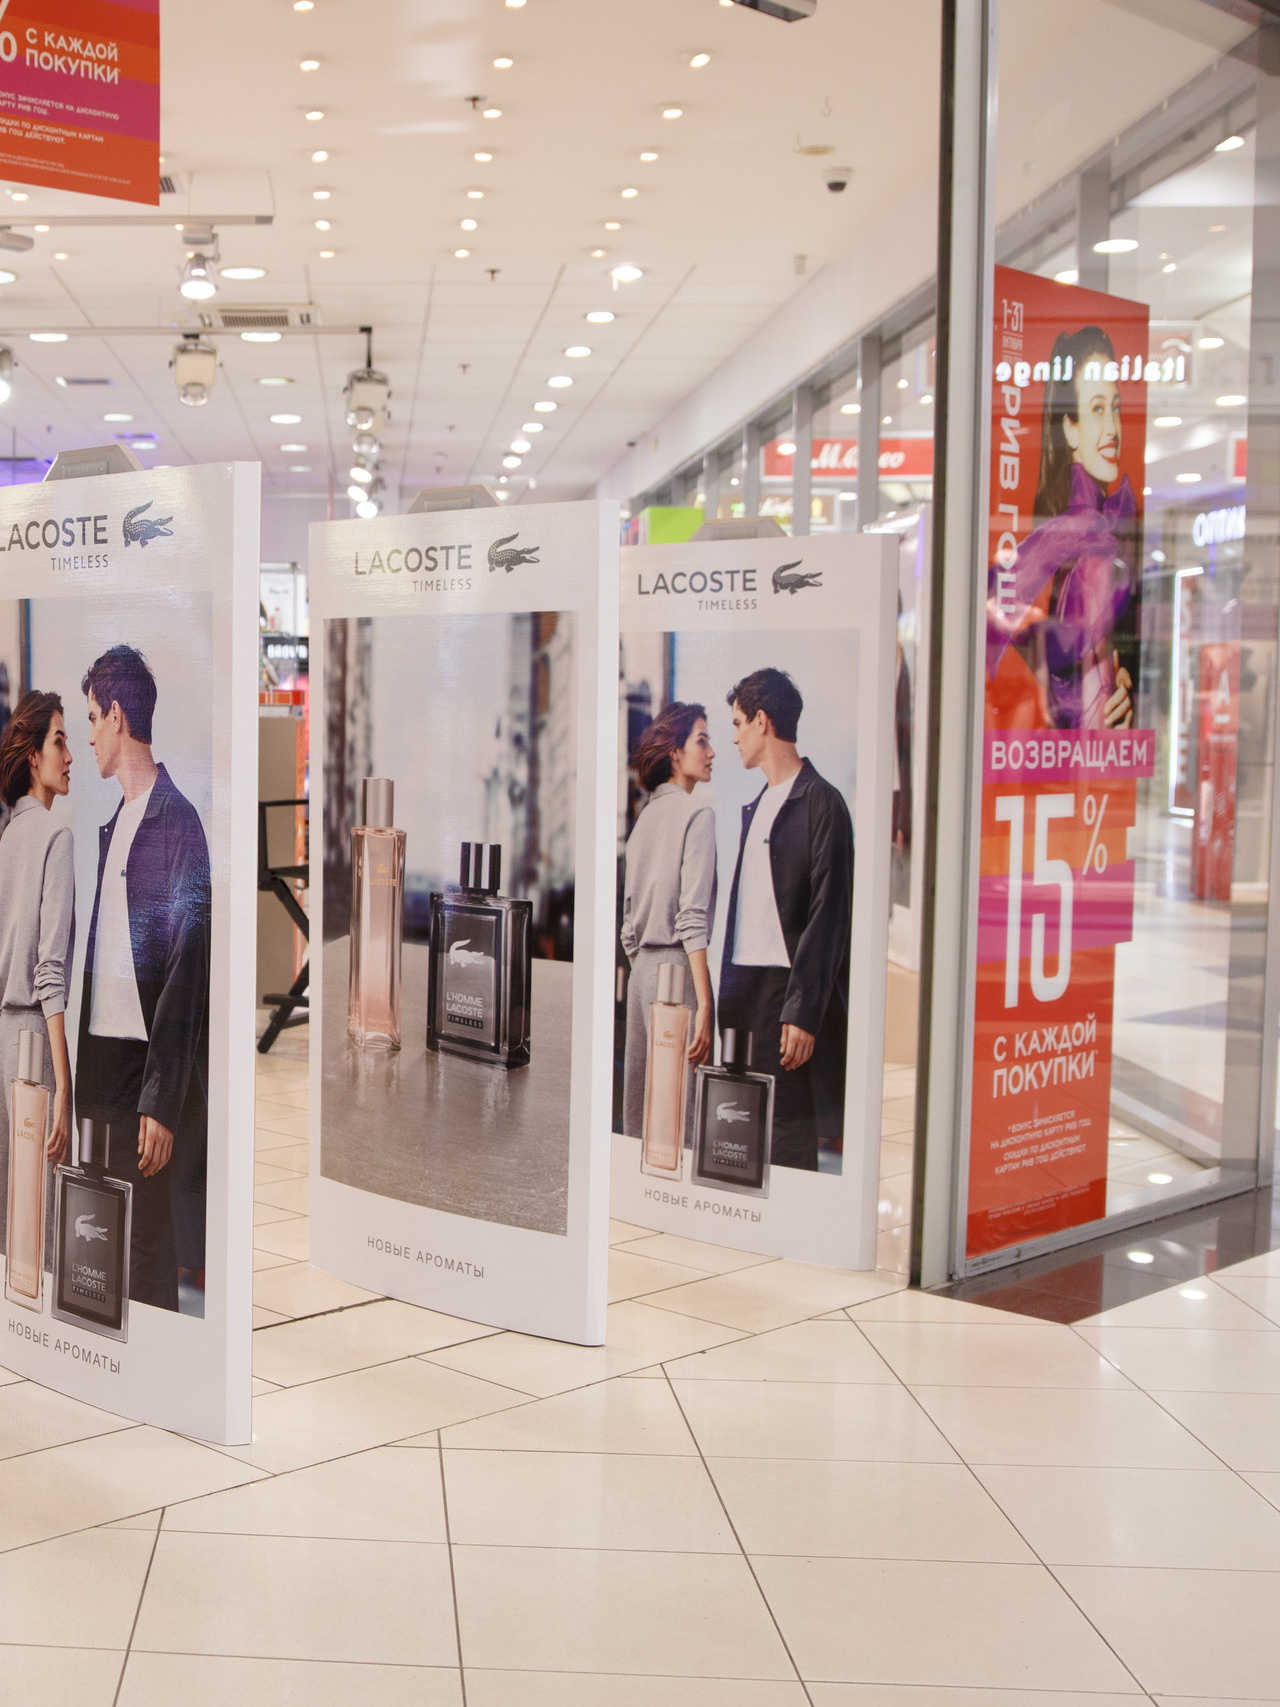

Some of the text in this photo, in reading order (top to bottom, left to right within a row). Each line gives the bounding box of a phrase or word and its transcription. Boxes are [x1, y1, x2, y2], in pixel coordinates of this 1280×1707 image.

[25, 27, 118, 63] С КАЖДОЙ
[1002, 298, 1023, 333] 1-31
[51, 554, 109, 570] TIMELESS
[354, 544, 472, 575] LACOSTE
[413, 578, 472, 592] TIMELESS
[637, 569, 757, 595] LACOSTE
[698, 599, 758, 611] TIMELESS
[991, 740, 1148, 773] ВОЗВРАЩАЕМ
[446, 991, 483, 1008] L'HOMME
[446, 1002, 483, 1019] LACOSTE
[993, 1014, 1097, 1063] С КАЖДОЙ
[712, 1148, 748, 1161] LACOSTE
[644, 1188, 762, 1223] НОВЫЕ АРОМАТЫ
[367, 1236, 485, 1279] НОВЫЕ АРОМАТЫ
[71, 1274, 107, 1291] LACOSTE
[72, 1262, 107, 1282] L'HOMME
[8, 1318, 120, 1375] НОВЫЕ АРОМАТЫ
